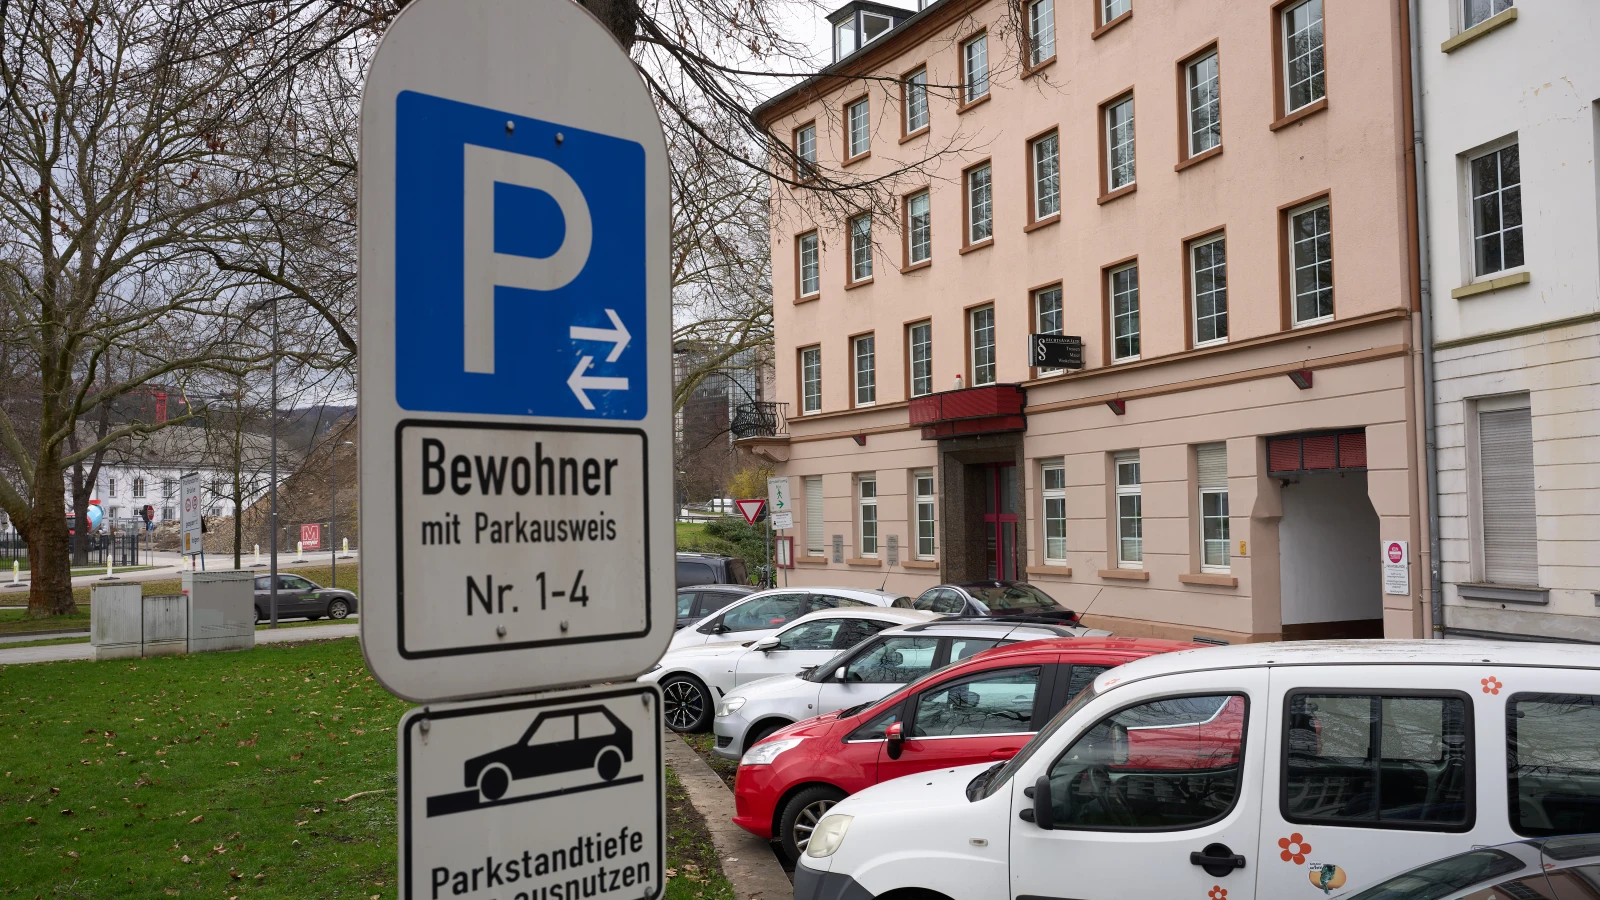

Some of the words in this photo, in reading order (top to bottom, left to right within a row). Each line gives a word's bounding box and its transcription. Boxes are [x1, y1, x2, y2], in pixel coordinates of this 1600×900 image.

[464, 143, 593, 374] P
[421, 437, 619, 497] Bewohner
[421, 512, 461, 546] mit
[474, 511, 617, 545] Parkausweis
[466, 574, 519, 616] Nr.
[431, 826, 643, 900] Parkstandtiefe
